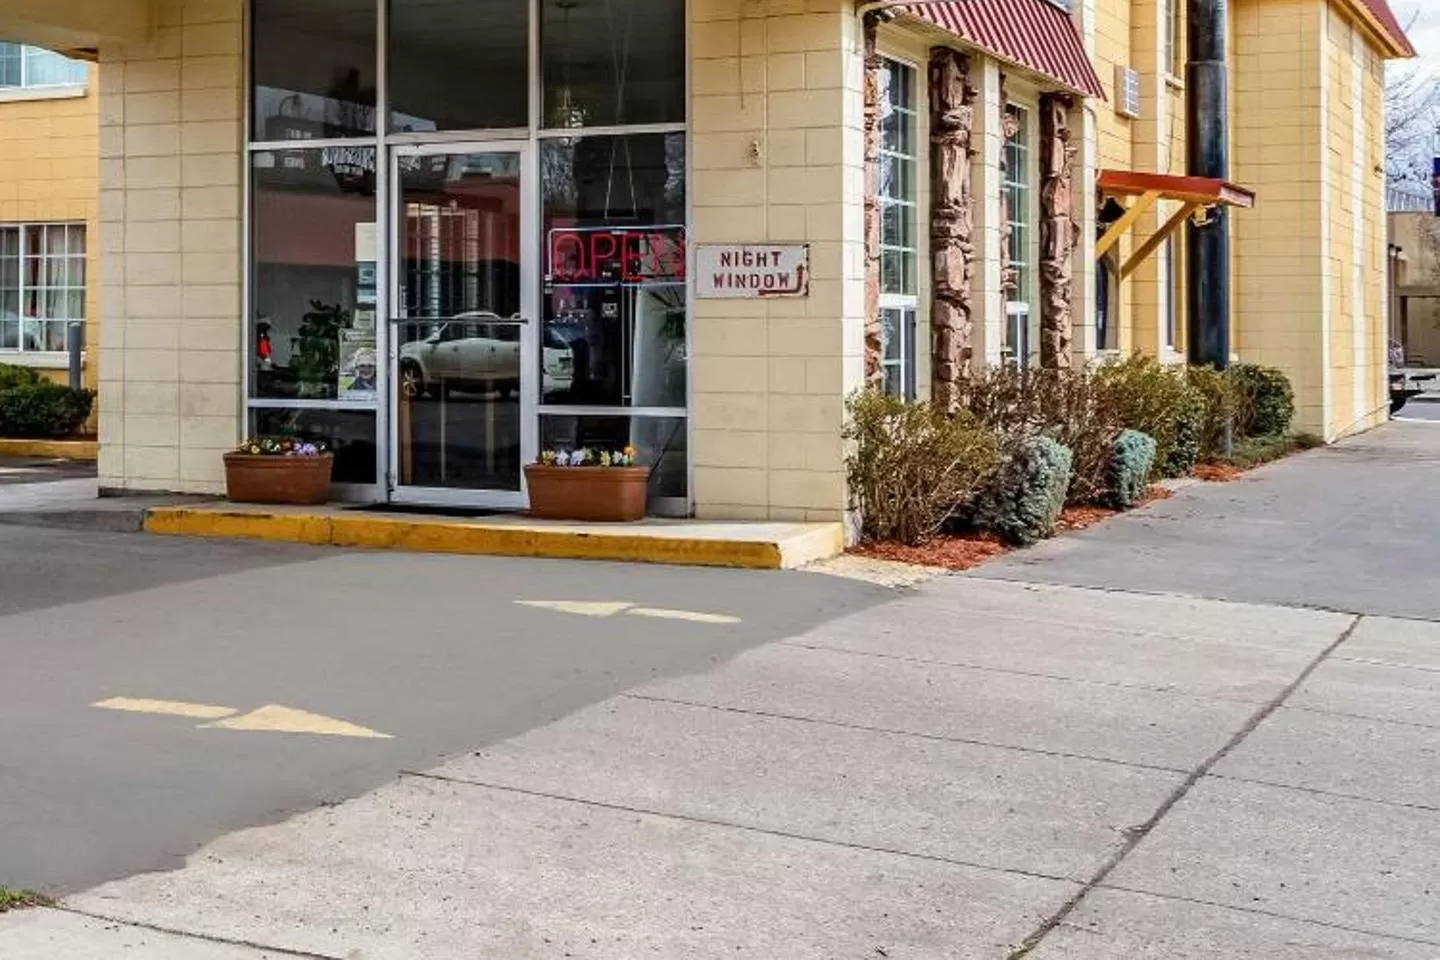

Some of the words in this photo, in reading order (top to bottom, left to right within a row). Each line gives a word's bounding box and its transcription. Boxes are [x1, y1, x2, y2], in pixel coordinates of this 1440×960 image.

[554, 232, 686, 281] OPEN
[721, 248, 782, 268] NIGHT
[713, 272, 790, 289] WINDOW
